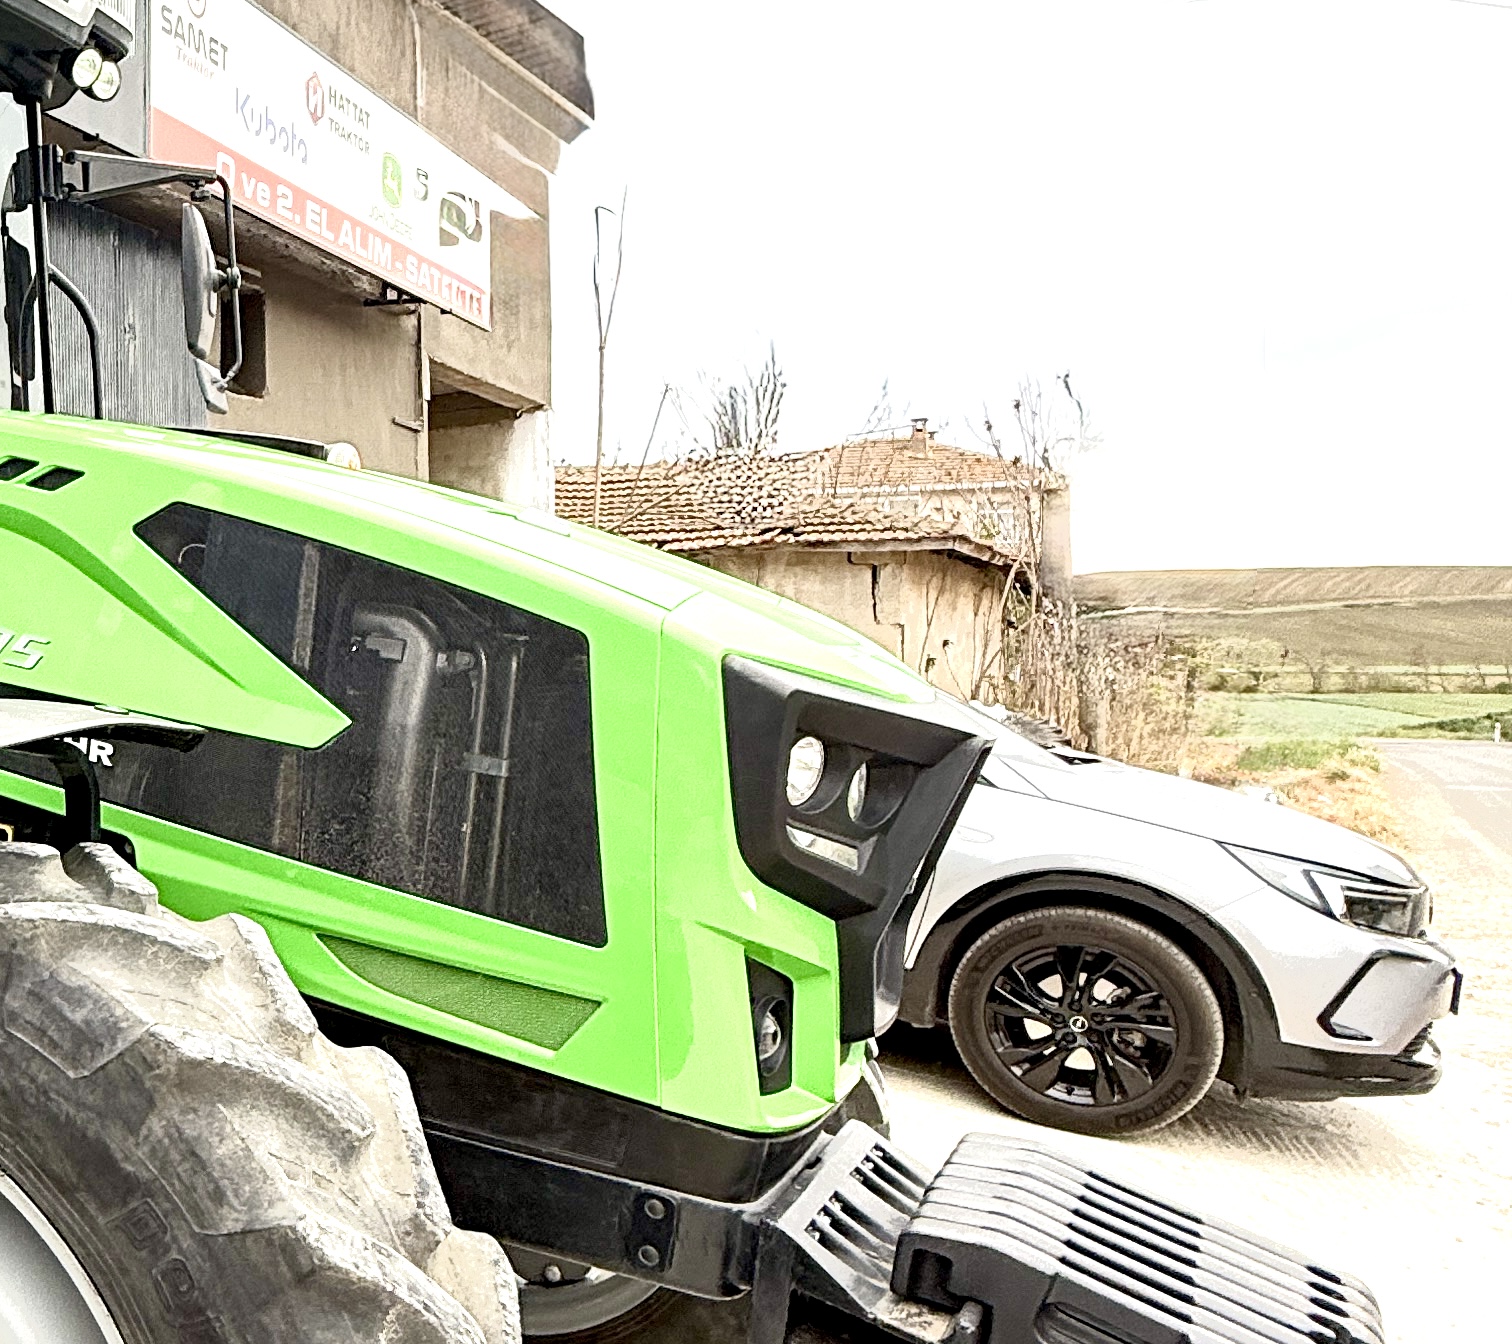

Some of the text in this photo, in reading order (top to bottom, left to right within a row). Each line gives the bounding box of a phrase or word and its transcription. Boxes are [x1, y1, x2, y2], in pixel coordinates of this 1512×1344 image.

[161, 4, 229, 72] SAMET
[235, 86, 308, 165] Kubota
[328, 84, 371, 130] HATTAT
[240, 171, 270, 207] ve
[276, 185, 300, 225] 2.
[305, 203, 335, 241] EL
[338, 220, 392, 271] ALIM
